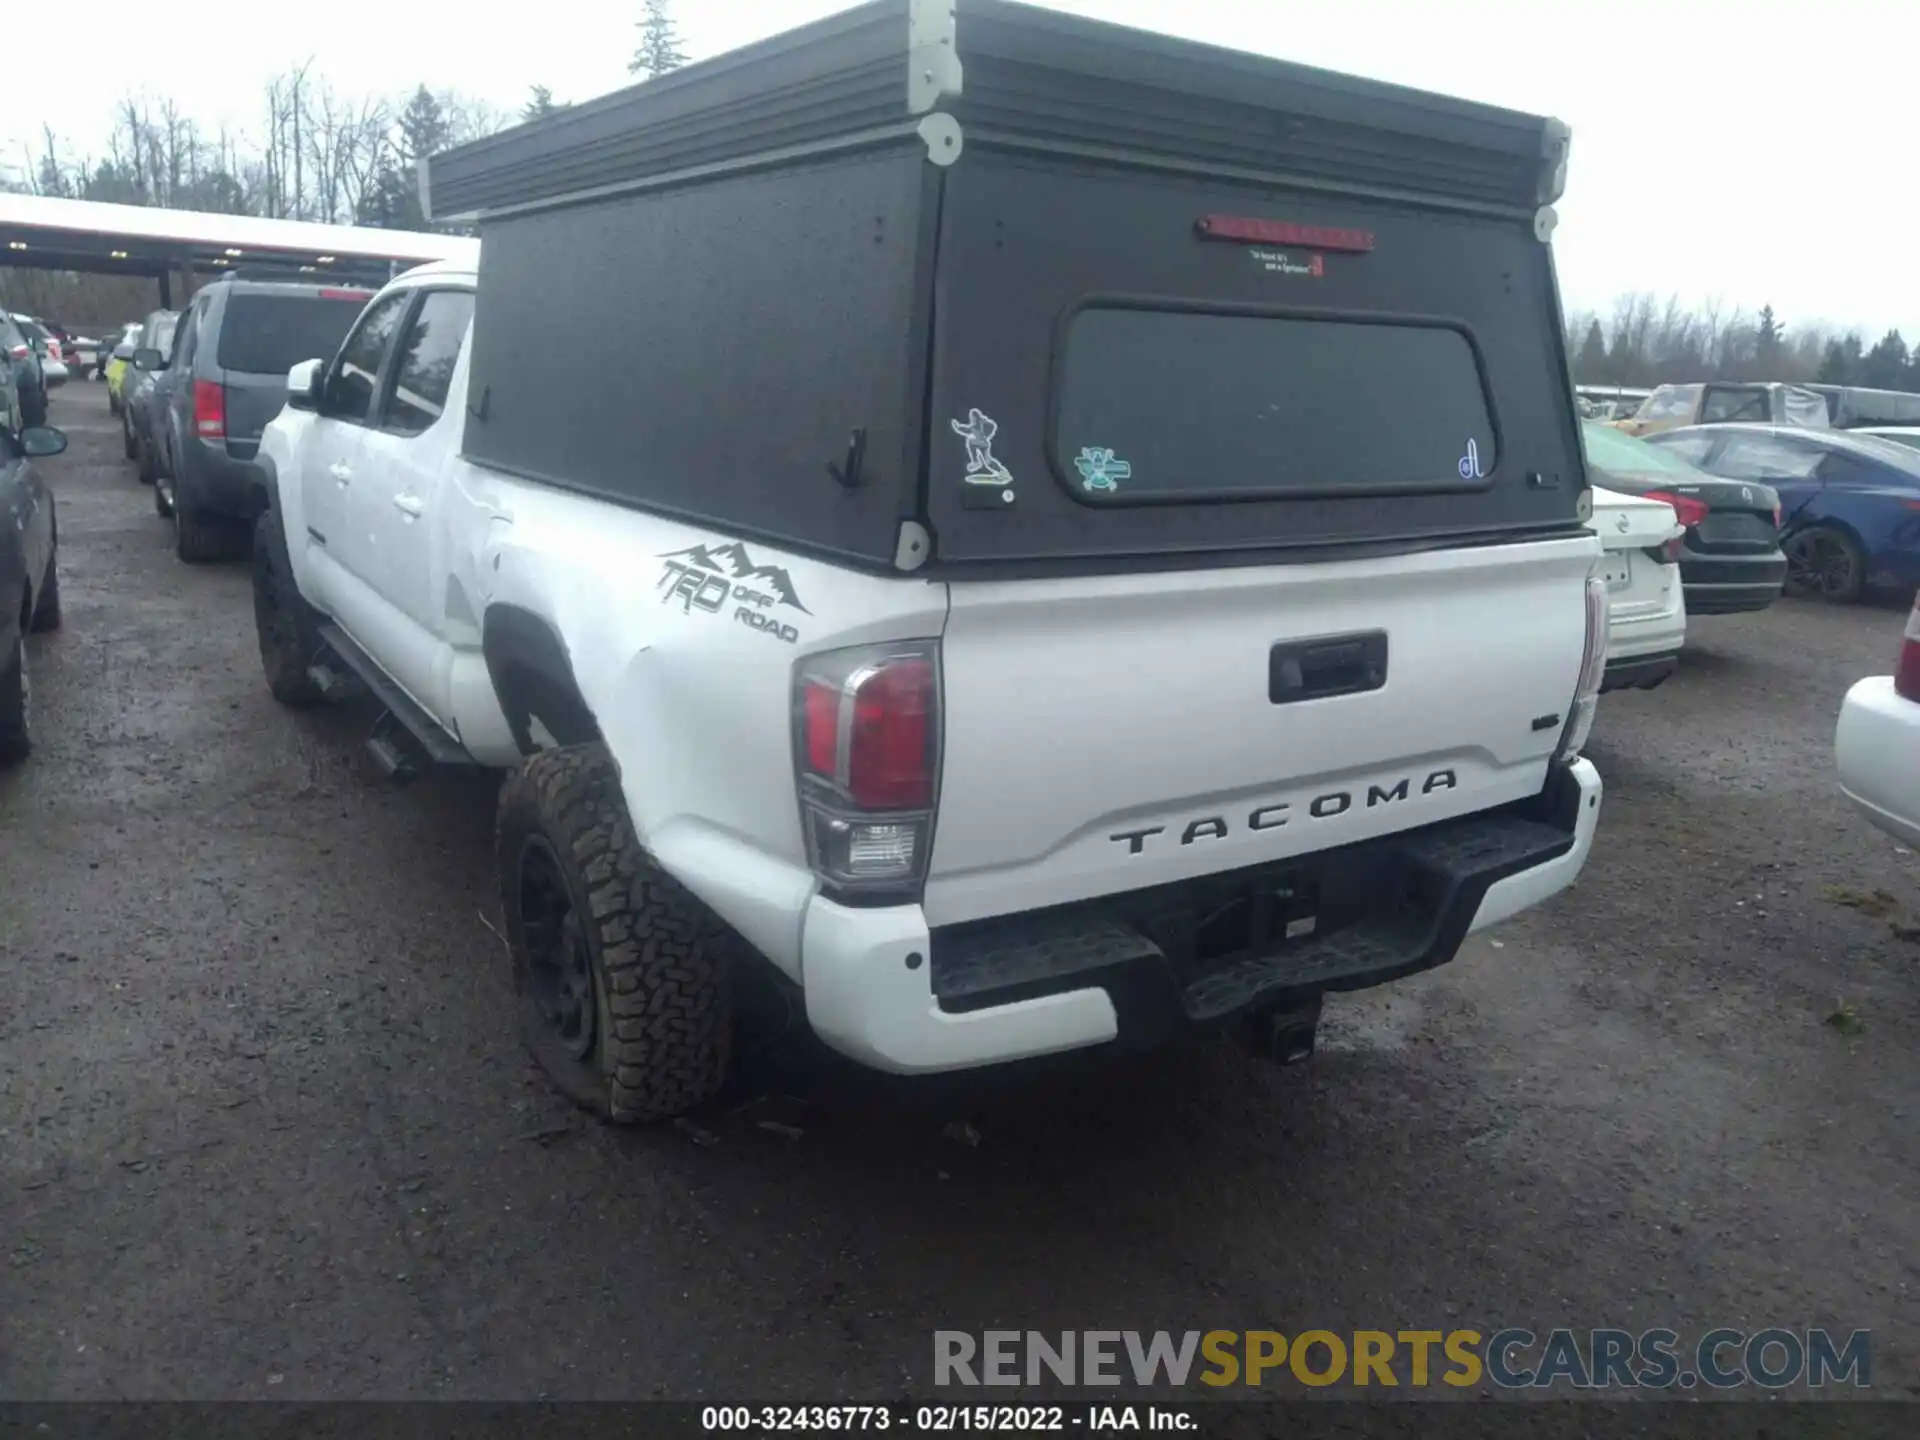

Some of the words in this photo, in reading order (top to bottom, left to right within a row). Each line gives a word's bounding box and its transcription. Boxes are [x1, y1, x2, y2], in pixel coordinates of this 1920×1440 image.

[655, 559, 731, 615] TRD
[731, 584, 776, 608] OFF
[733, 606, 799, 644] ROAD
[1109, 768, 1458, 855] TACOMA
